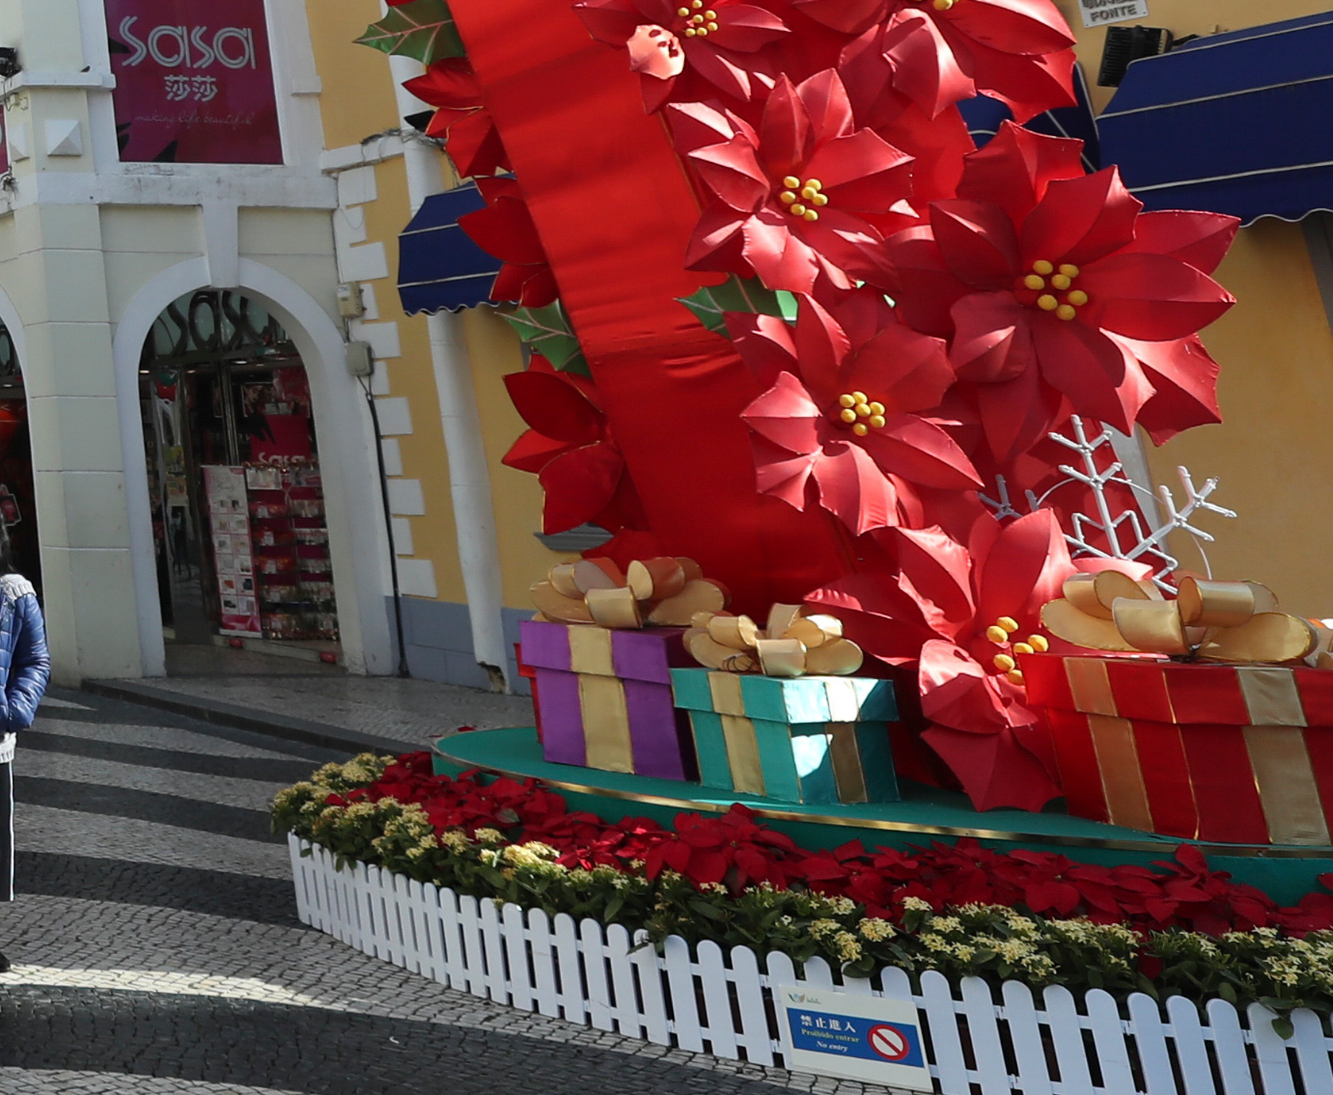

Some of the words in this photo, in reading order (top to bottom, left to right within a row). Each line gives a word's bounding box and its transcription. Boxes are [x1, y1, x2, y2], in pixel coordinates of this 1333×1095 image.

[1090, 4, 1137, 22] FONTE
[164, 74, 219, 102] 莎莎
[816, 1040, 828, 1049] No
[828, 1044, 849, 1053] entry
